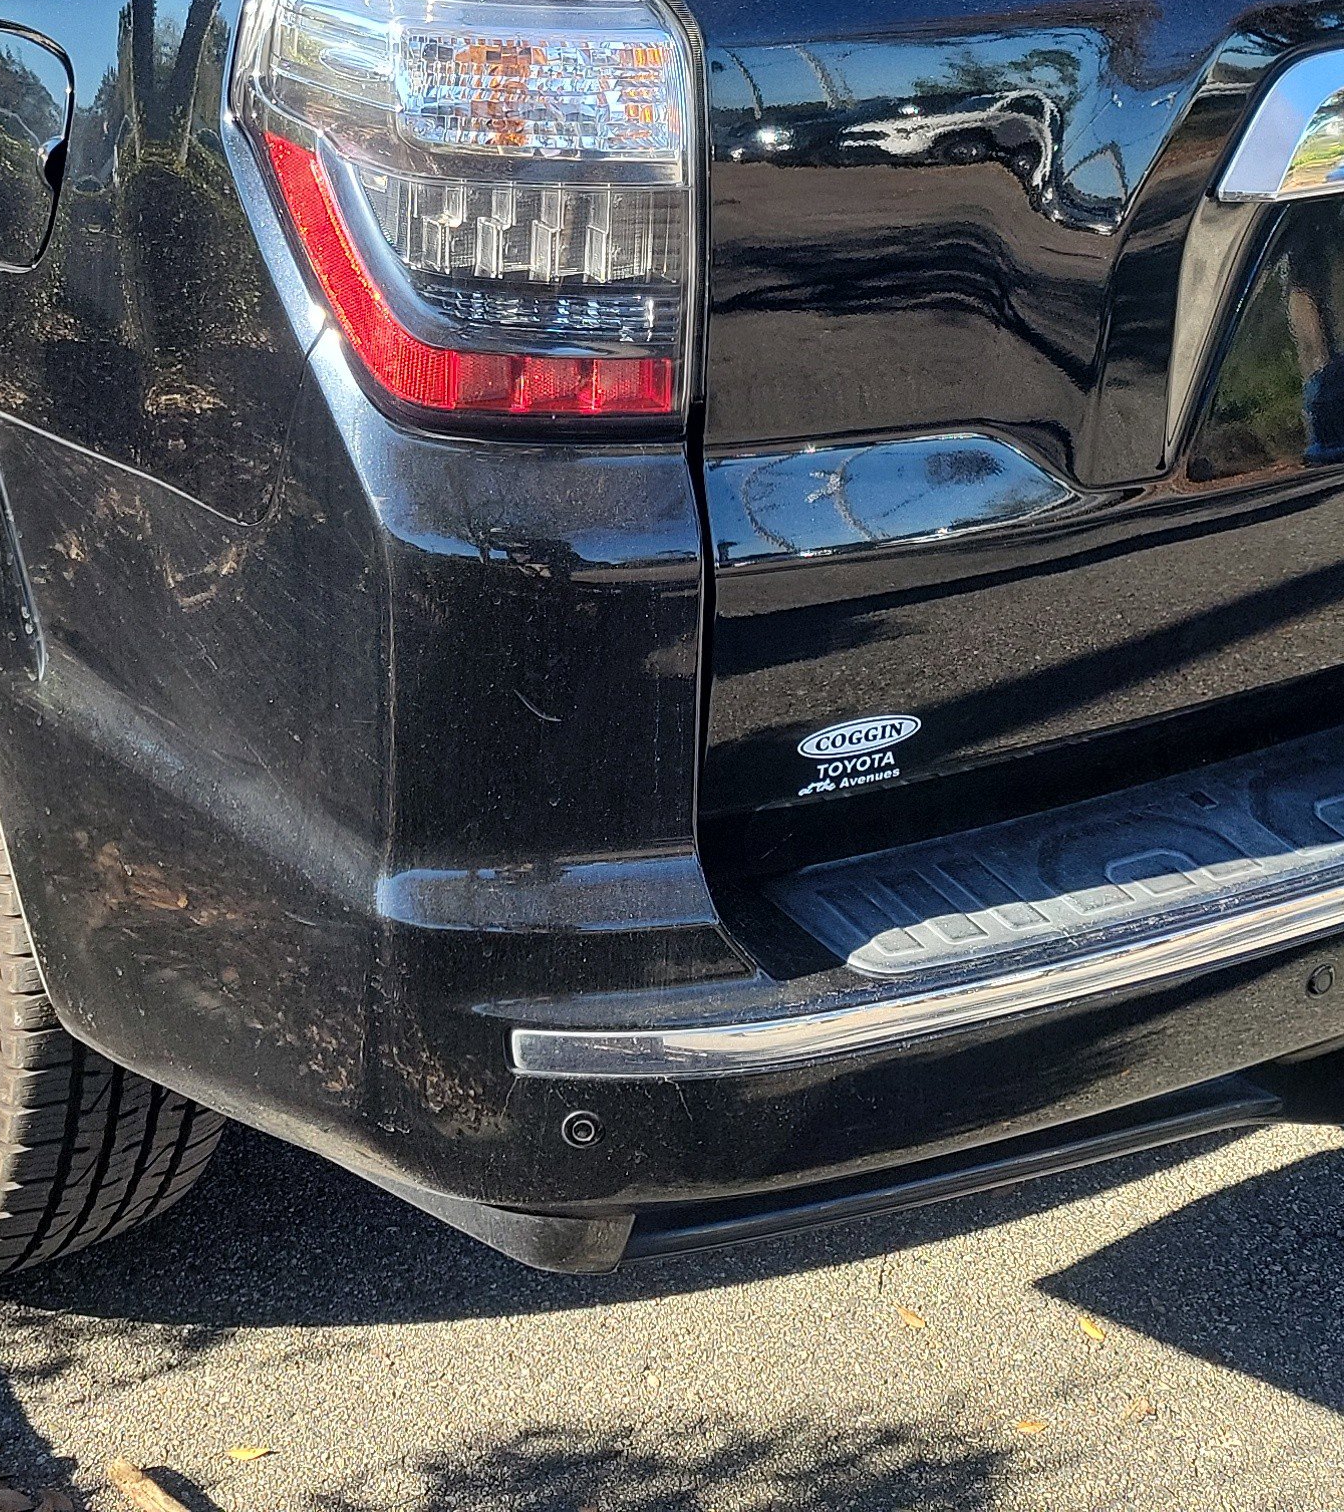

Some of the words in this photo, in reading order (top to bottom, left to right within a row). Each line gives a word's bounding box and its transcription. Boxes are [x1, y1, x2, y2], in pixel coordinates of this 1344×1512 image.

[815, 721, 905, 752] COGGIN
[816, 751, 895, 779] TOYOTA
[839, 767, 900, 789] Avenues
